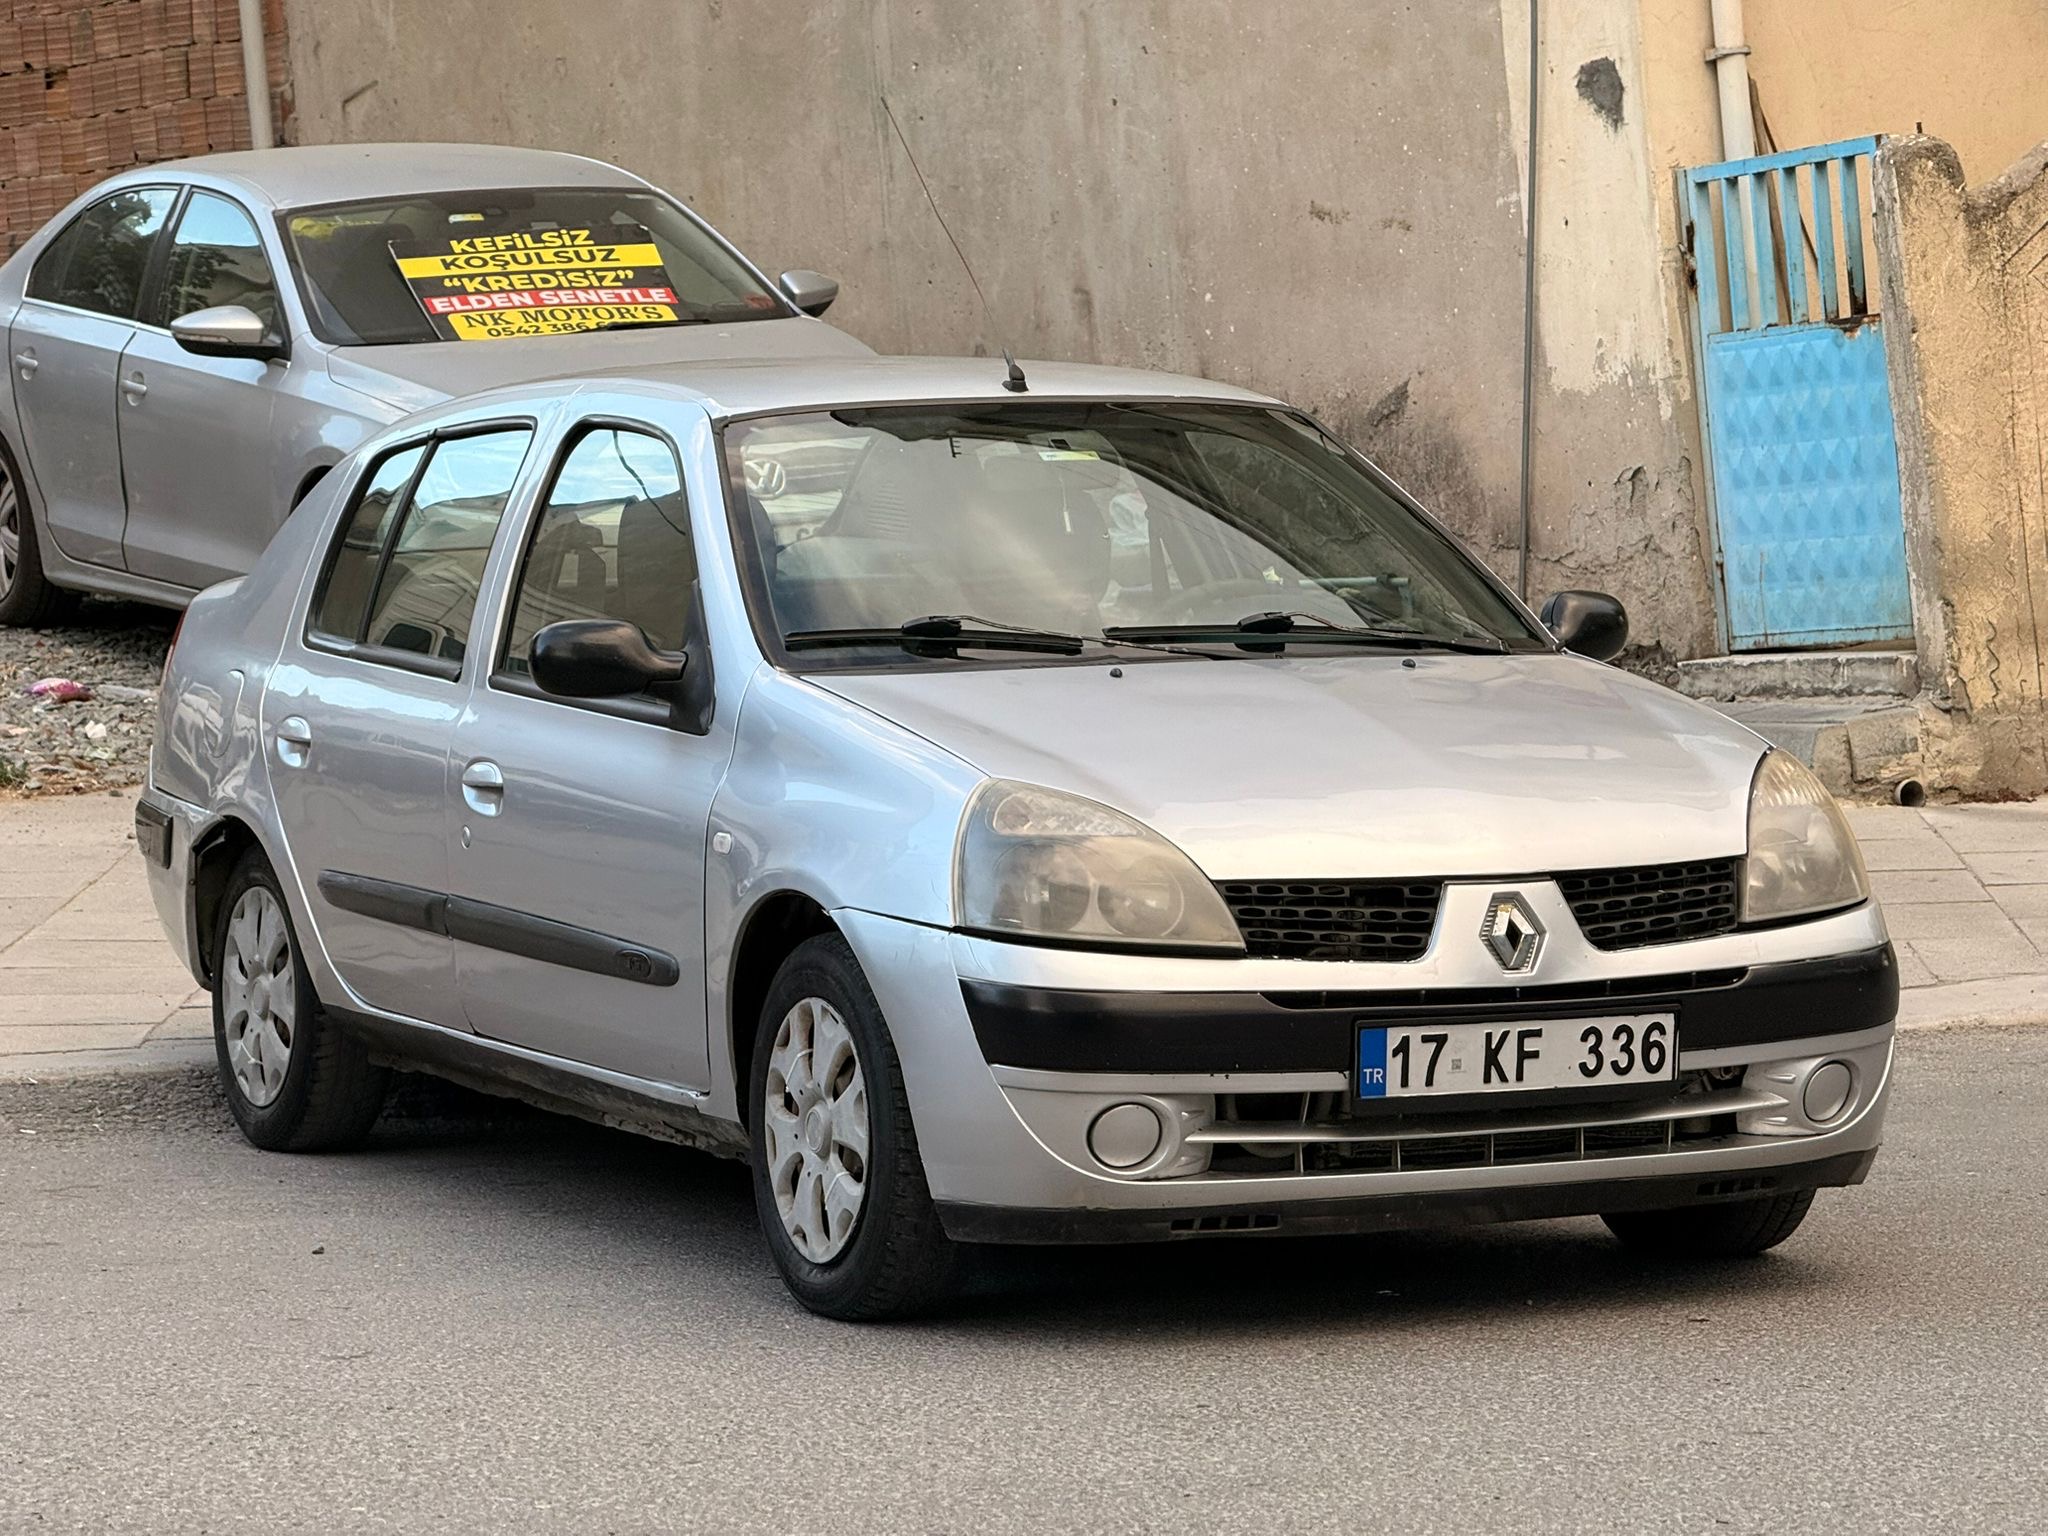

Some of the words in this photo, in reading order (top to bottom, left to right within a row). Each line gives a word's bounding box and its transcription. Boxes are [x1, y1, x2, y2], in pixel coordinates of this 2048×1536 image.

[440, 248, 621, 270] KOŞULSUZ
[433, 293, 532, 313] ELDEN
[543, 288, 671, 305] SENETLE
[462, 312, 508, 328] NK
[487, 324, 545, 337] 0542
[549, 322, 590, 333] 386
[1391, 1033, 1449, 1088] 17
[1482, 1027, 1543, 1084] KF
[1578, 1021, 1667, 1078] 336
[1363, 1068, 1384, 1084] TR
